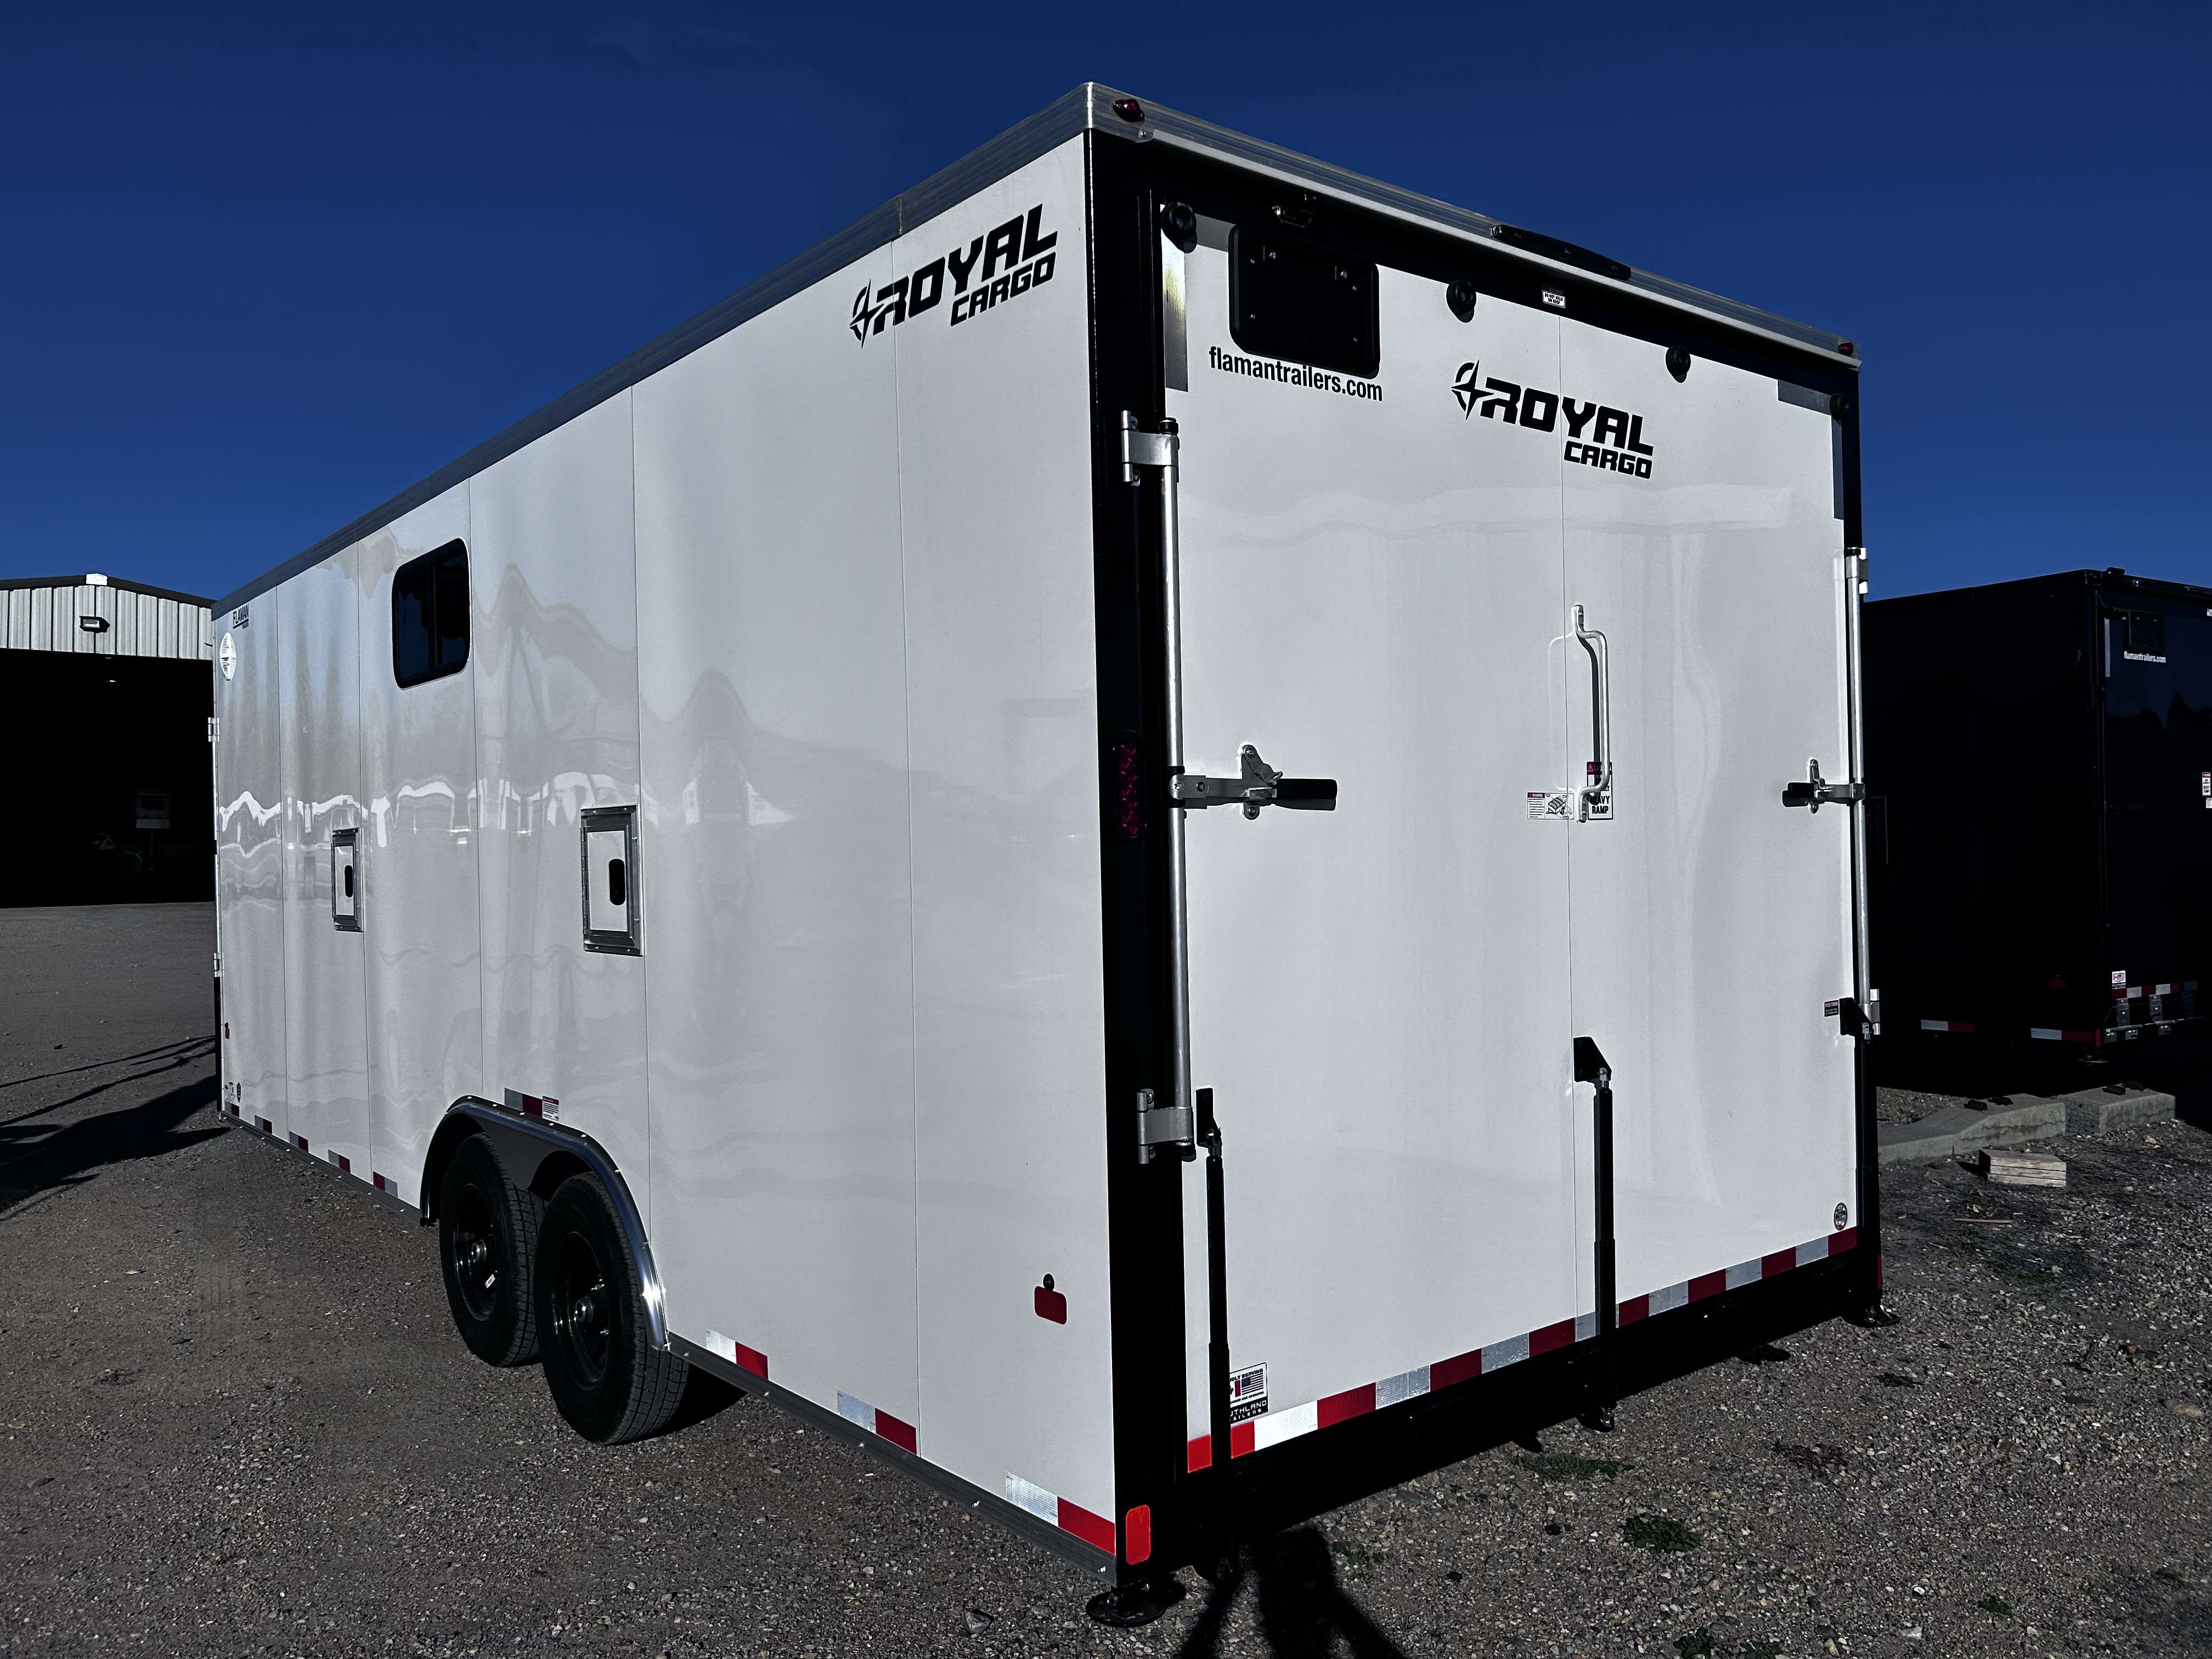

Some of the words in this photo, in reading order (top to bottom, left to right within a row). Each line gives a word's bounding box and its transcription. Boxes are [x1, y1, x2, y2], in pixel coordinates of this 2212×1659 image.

[873, 204, 1058, 336] ROYAL
[950, 252, 1056, 326] CARGO
[1209, 346, 1383, 402] flamantrailers.com
[1480, 376, 1654, 456] ROYAL
[1564, 440, 1652, 479] CARGO
[233, 603, 249, 626] FLAMAN
[1592, 805, 1609, 814] RAMP
[1242, 1368, 1263, 1378] SERVING
